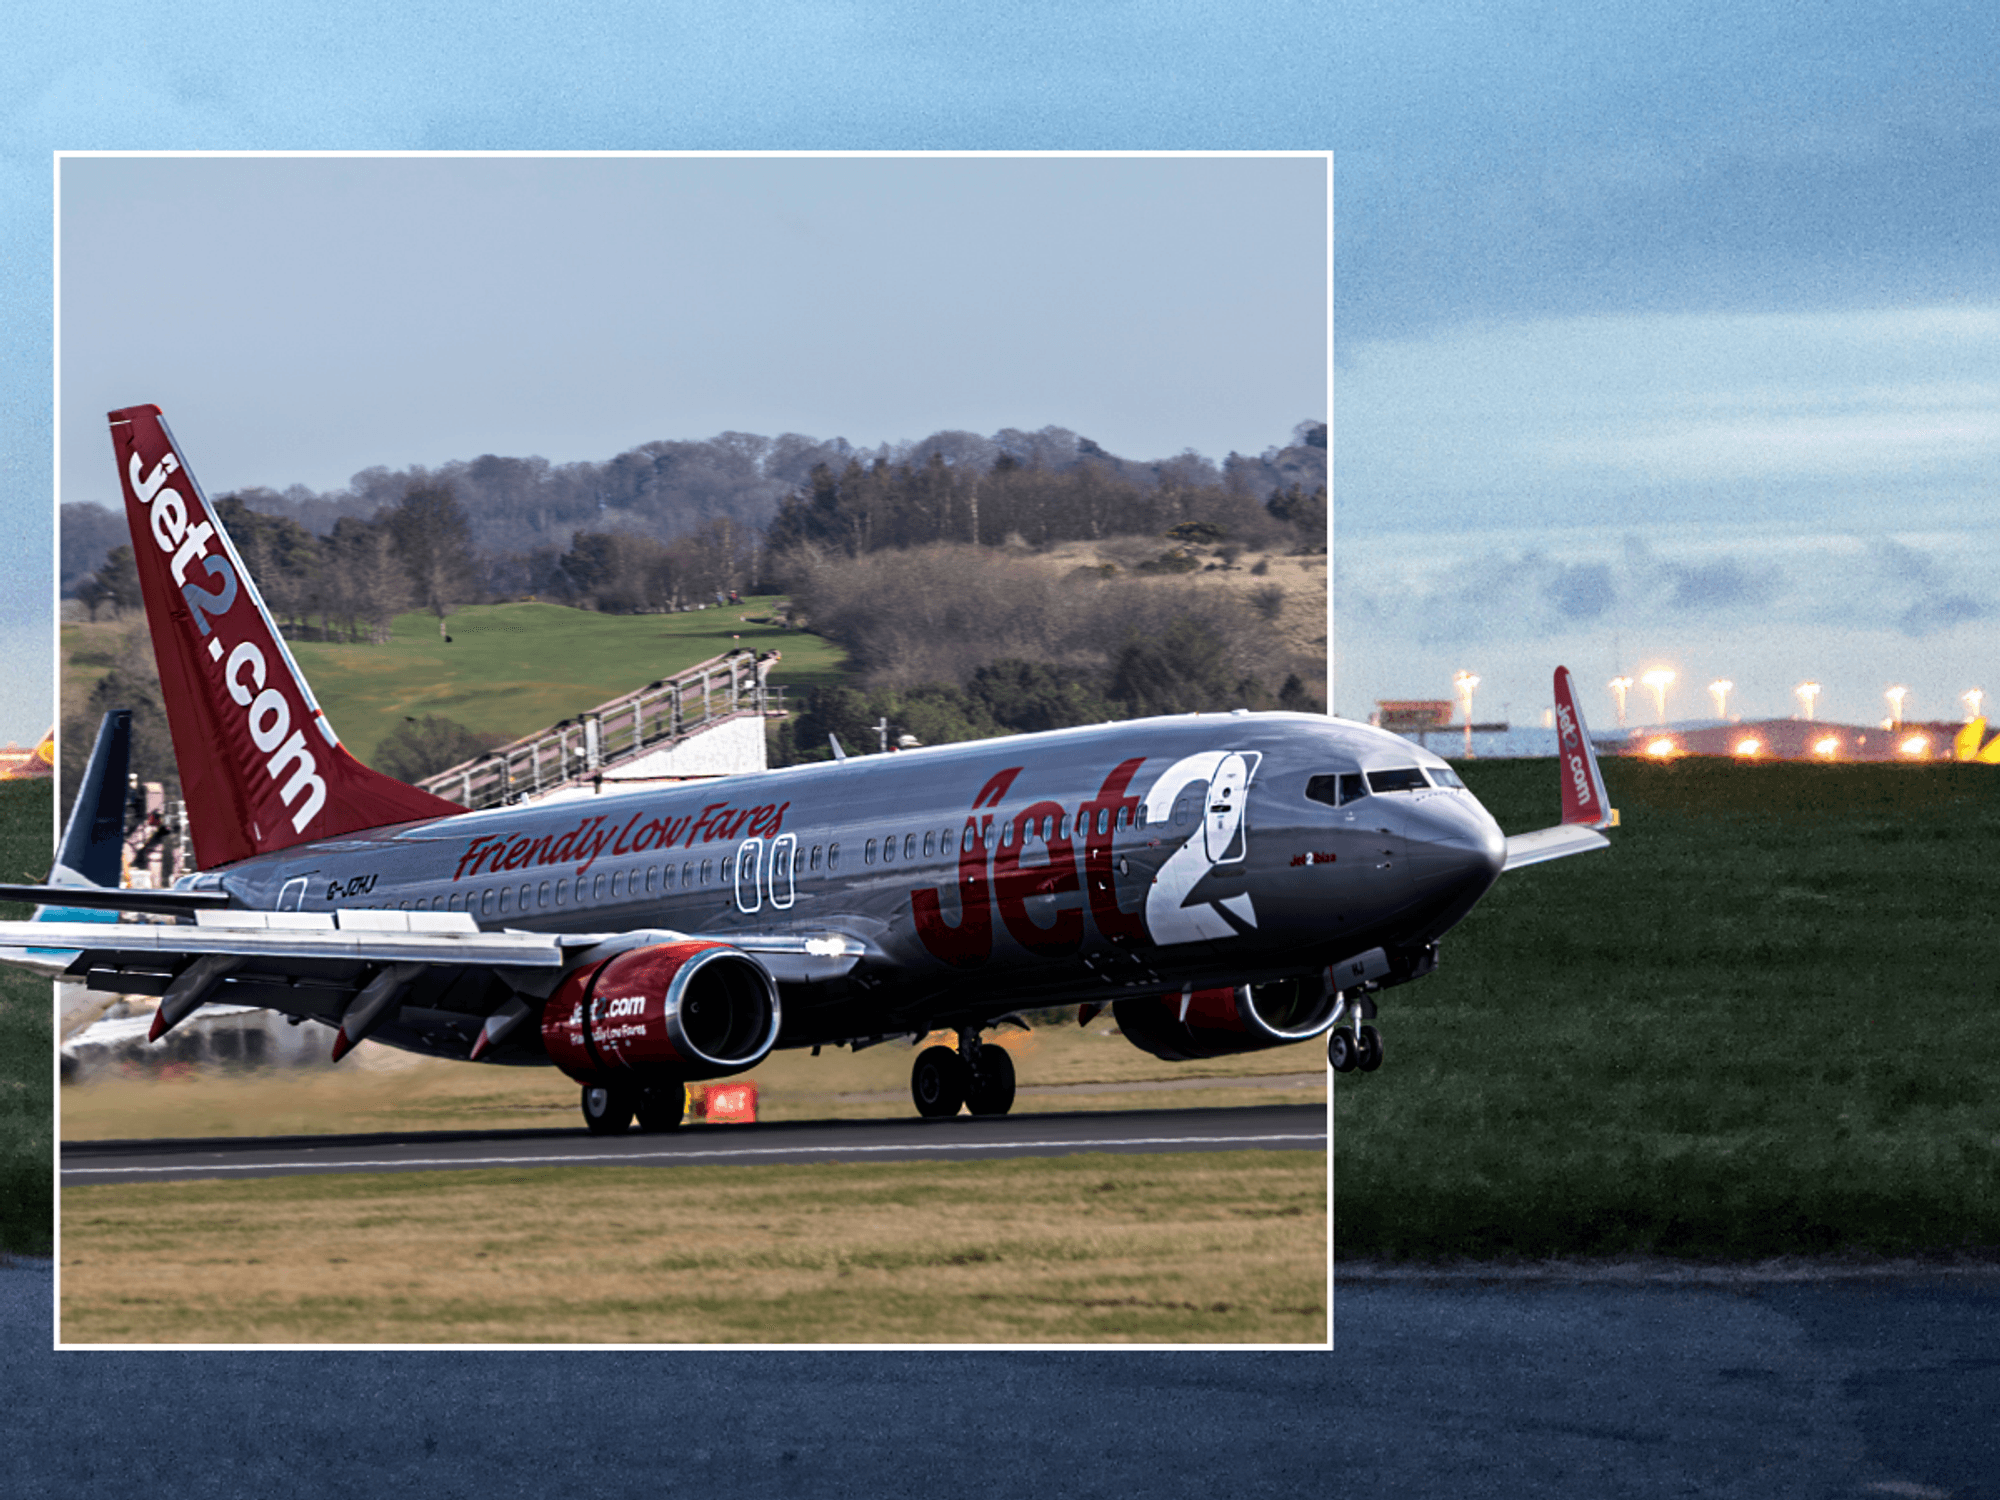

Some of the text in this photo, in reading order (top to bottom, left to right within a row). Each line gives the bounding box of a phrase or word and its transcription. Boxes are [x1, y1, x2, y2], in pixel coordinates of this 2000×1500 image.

[453, 801, 790, 882] Friendly Low Fares
[911, 751, 1257, 968] Jet2
